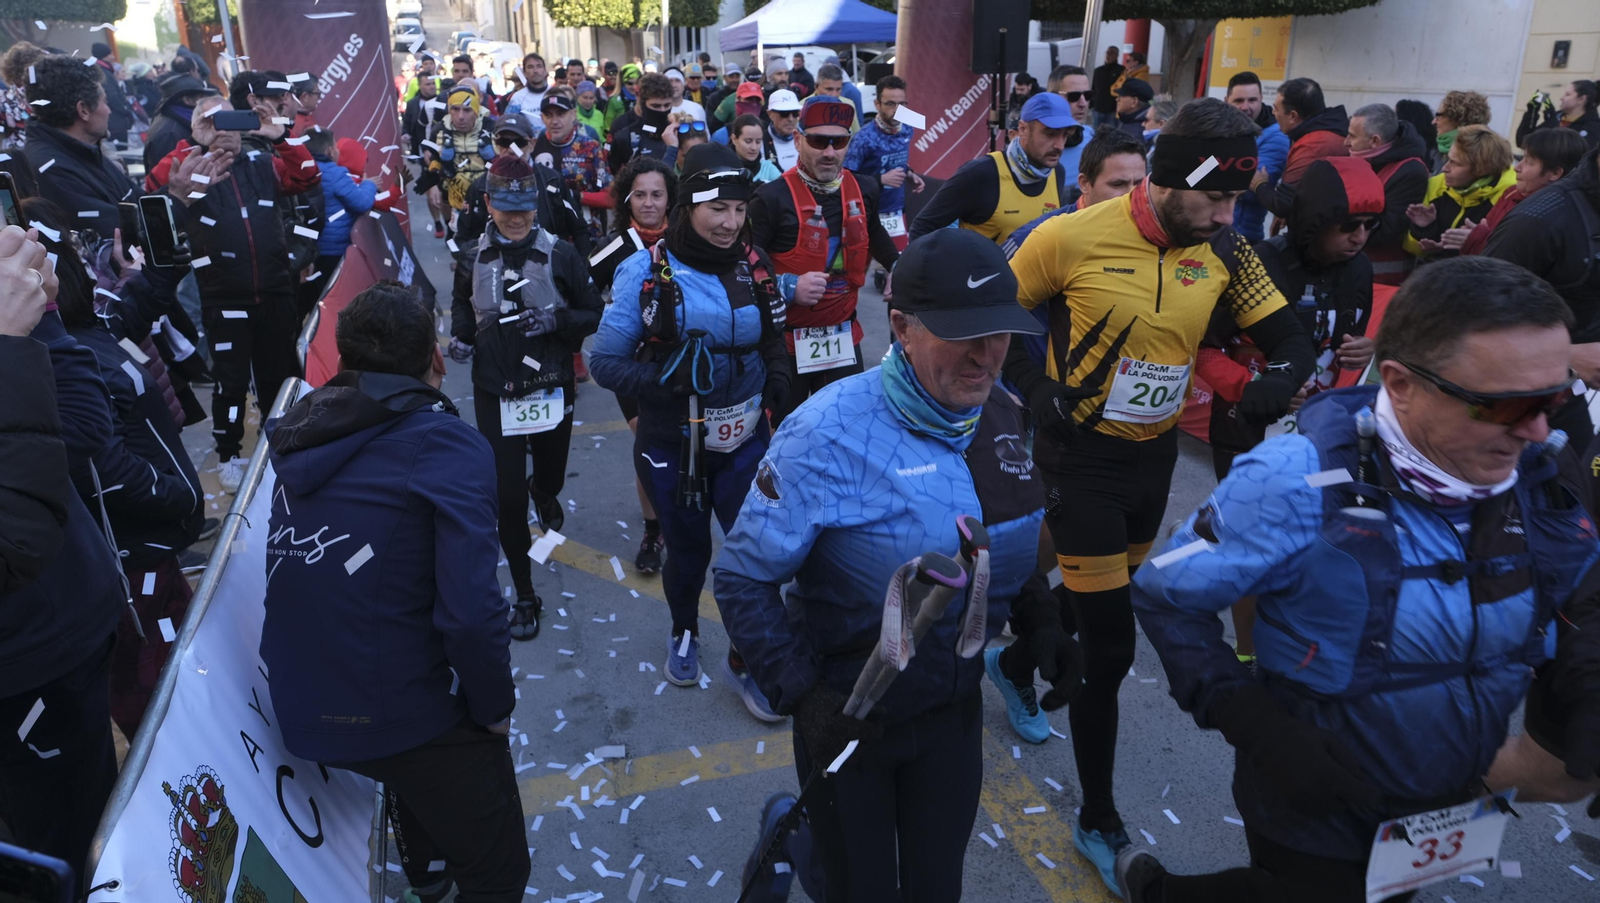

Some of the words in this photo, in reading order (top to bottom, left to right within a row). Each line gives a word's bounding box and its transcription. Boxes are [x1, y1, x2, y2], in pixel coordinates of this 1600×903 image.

[810, 338, 841, 359] 211
[1127, 369, 1139, 377] LA
[1134, 361, 1145, 370] IV
[1147, 363, 1170, 374] CxM
[1128, 382, 1183, 408] 204
[516, 403, 551, 422] 351
[717, 407, 734, 416] CxM
[717, 419, 745, 442] 95
[1411, 829, 1467, 869] 33
